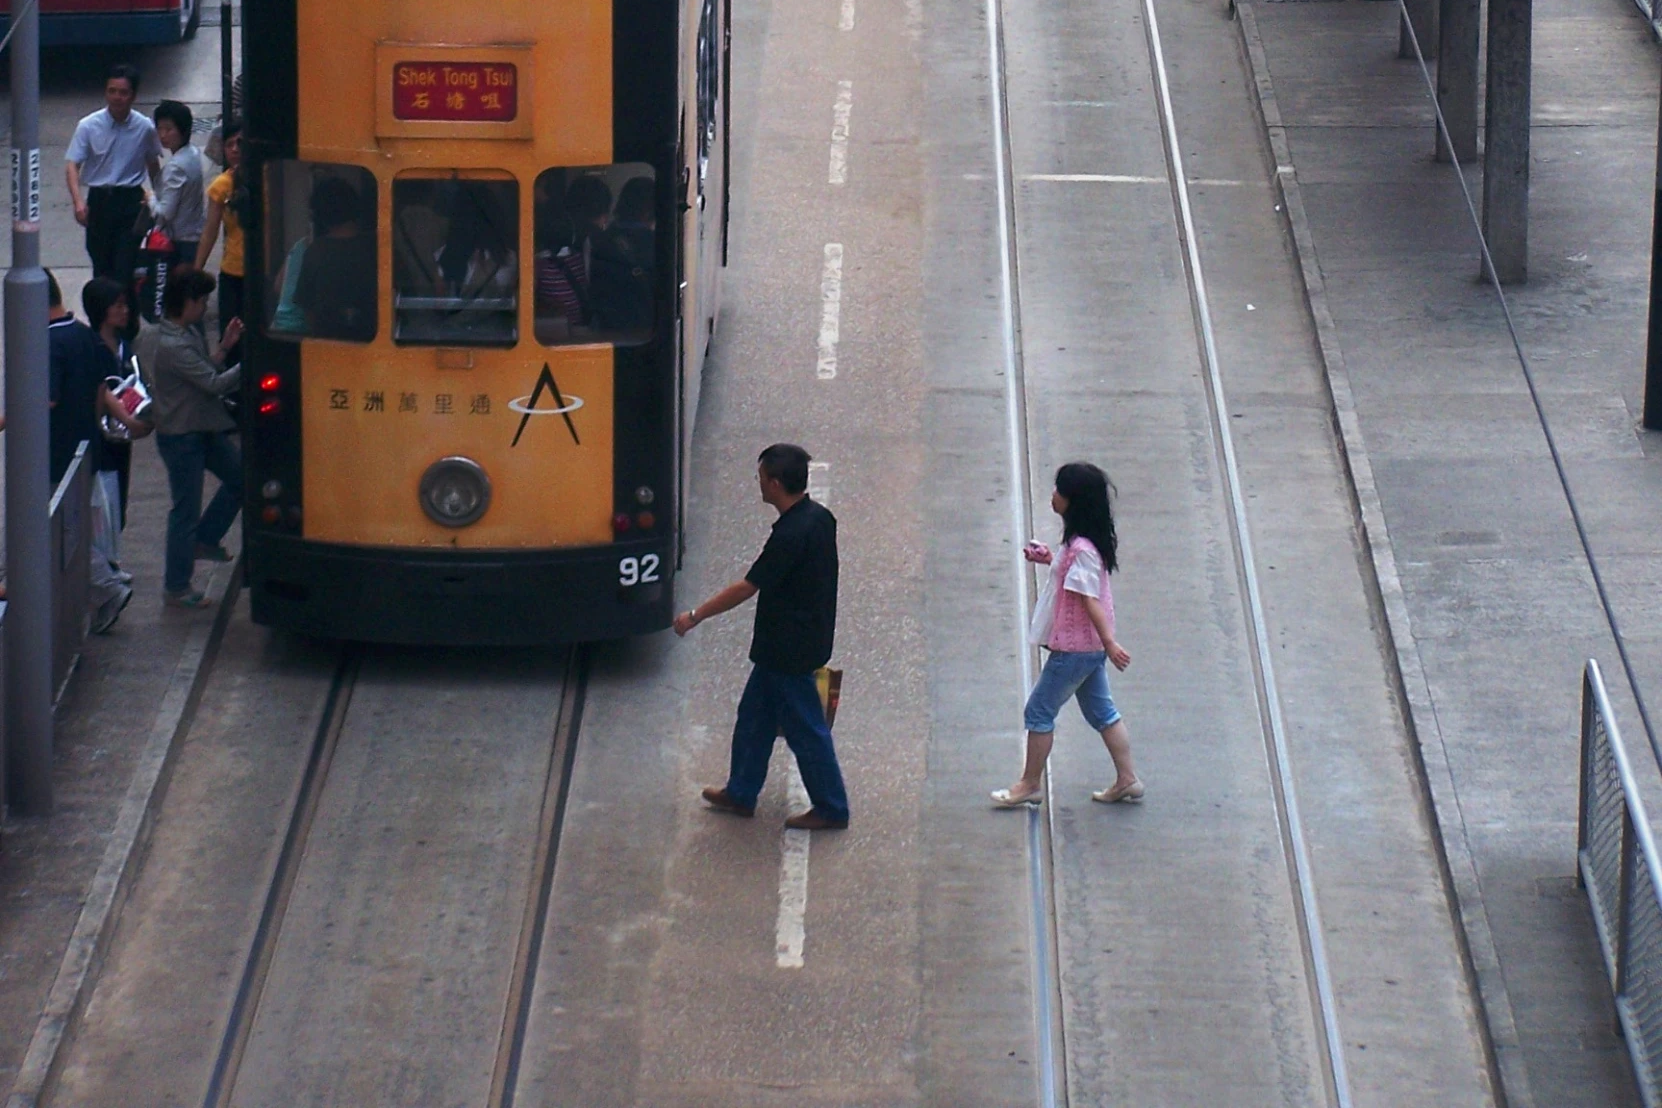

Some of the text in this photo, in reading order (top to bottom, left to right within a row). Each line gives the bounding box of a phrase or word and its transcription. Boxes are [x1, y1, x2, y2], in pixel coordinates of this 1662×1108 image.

[399, 67, 513, 90] Shek Tong Tsui
[30, 152, 39, 218] 27892
[328, 389, 492, 415] 亞洲萬里通
[619, 553, 660, 586] 92
